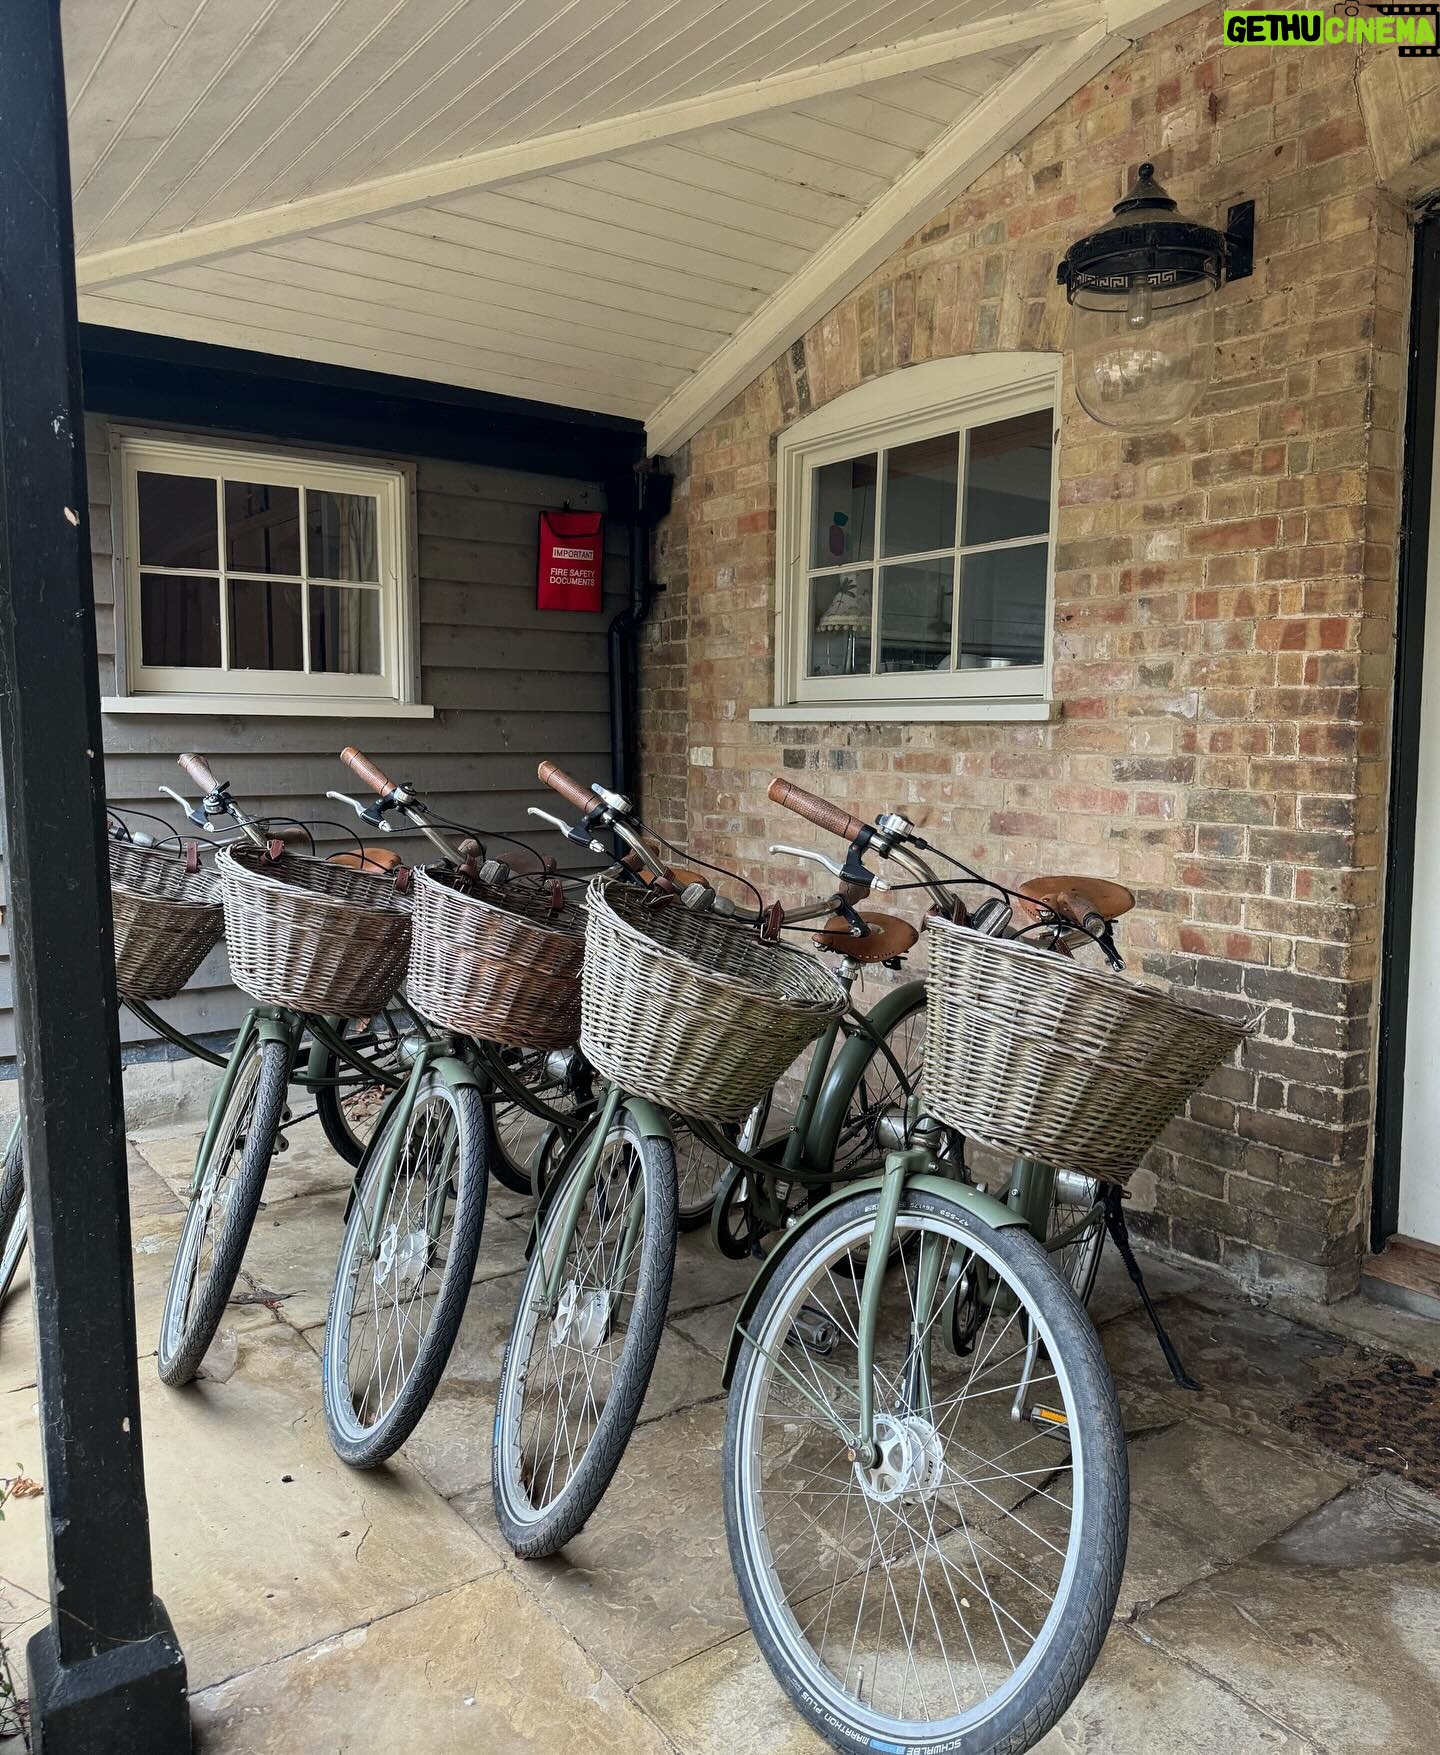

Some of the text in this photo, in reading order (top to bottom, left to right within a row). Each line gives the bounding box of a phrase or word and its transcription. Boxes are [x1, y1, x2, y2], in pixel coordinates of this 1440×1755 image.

[553, 548, 593, 559] IMPORTANT
[550, 568, 595, 578] FIRE SAFETY
[549, 576, 595, 586] DOCUMENTS
[801, 1691, 962, 1755] SCHWALBE MARATHON PLUS
